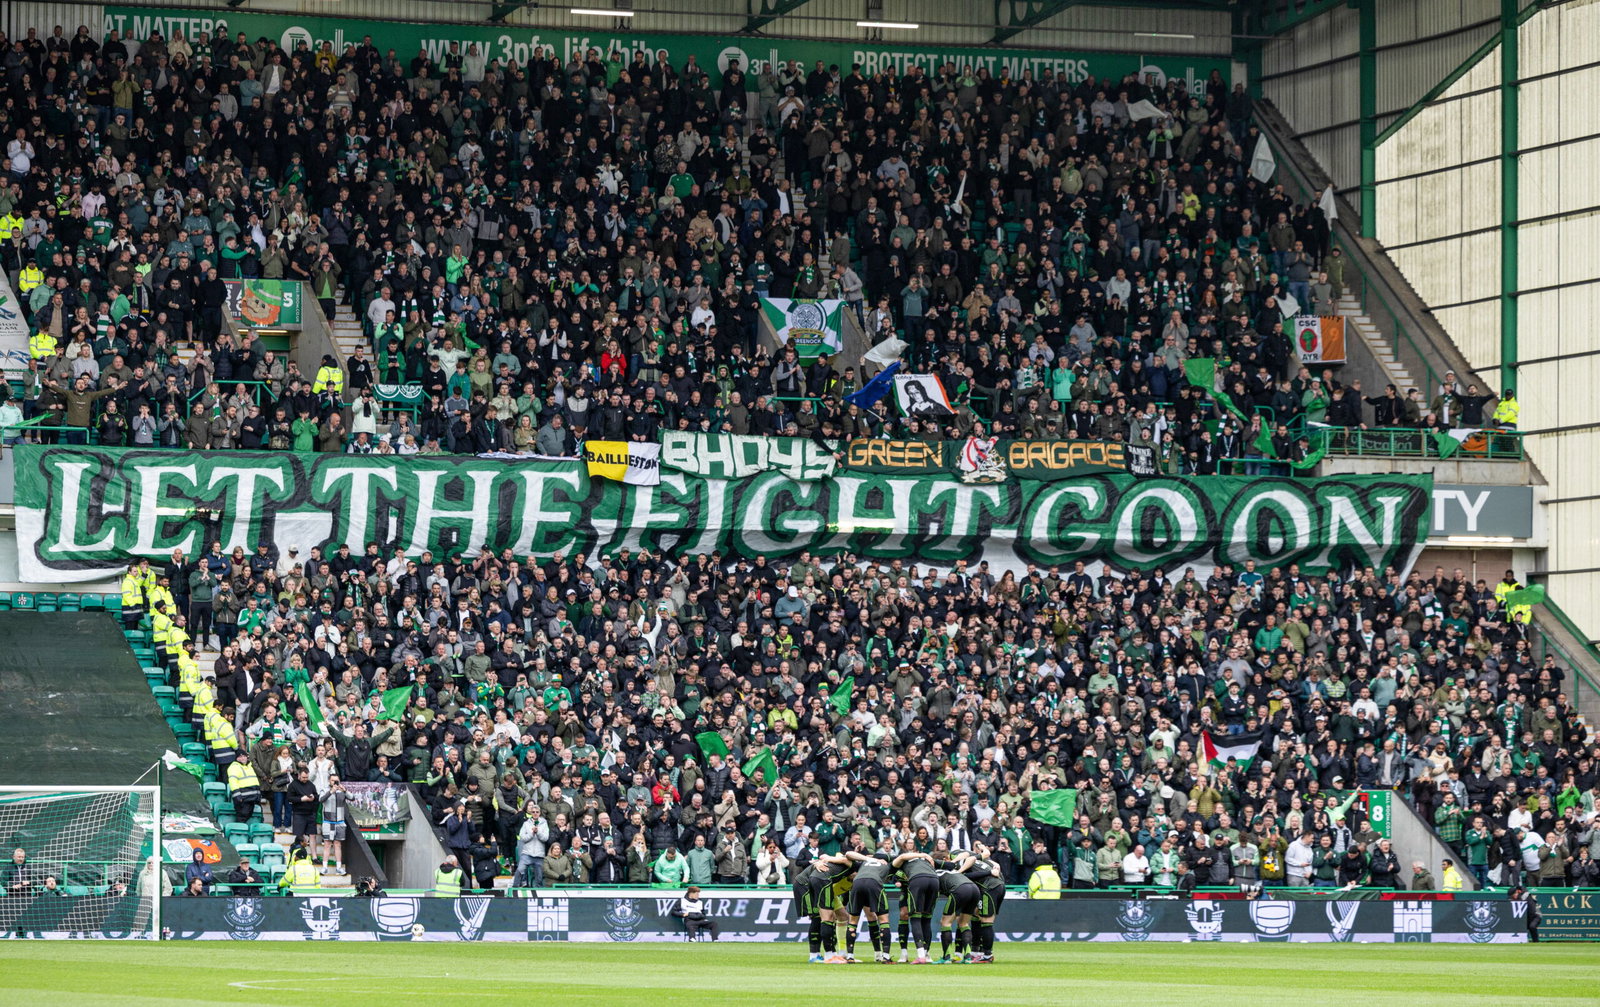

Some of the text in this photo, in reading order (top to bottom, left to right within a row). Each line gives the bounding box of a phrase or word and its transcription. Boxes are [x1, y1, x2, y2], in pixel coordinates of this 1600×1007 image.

[853, 51, 1089, 83] PROTECT WHAT MATTERS
[283, 292, 294, 307] 5
[587, 451, 657, 470] BAILLIESTON
[849, 438, 943, 468] GREEN
[1009, 441, 1126, 470] BRIGADE
[49, 463, 1402, 570] LET THE FIGHT GO ON
[1432, 489, 1491, 532] TY
[1372, 805, 1384, 822] 8
